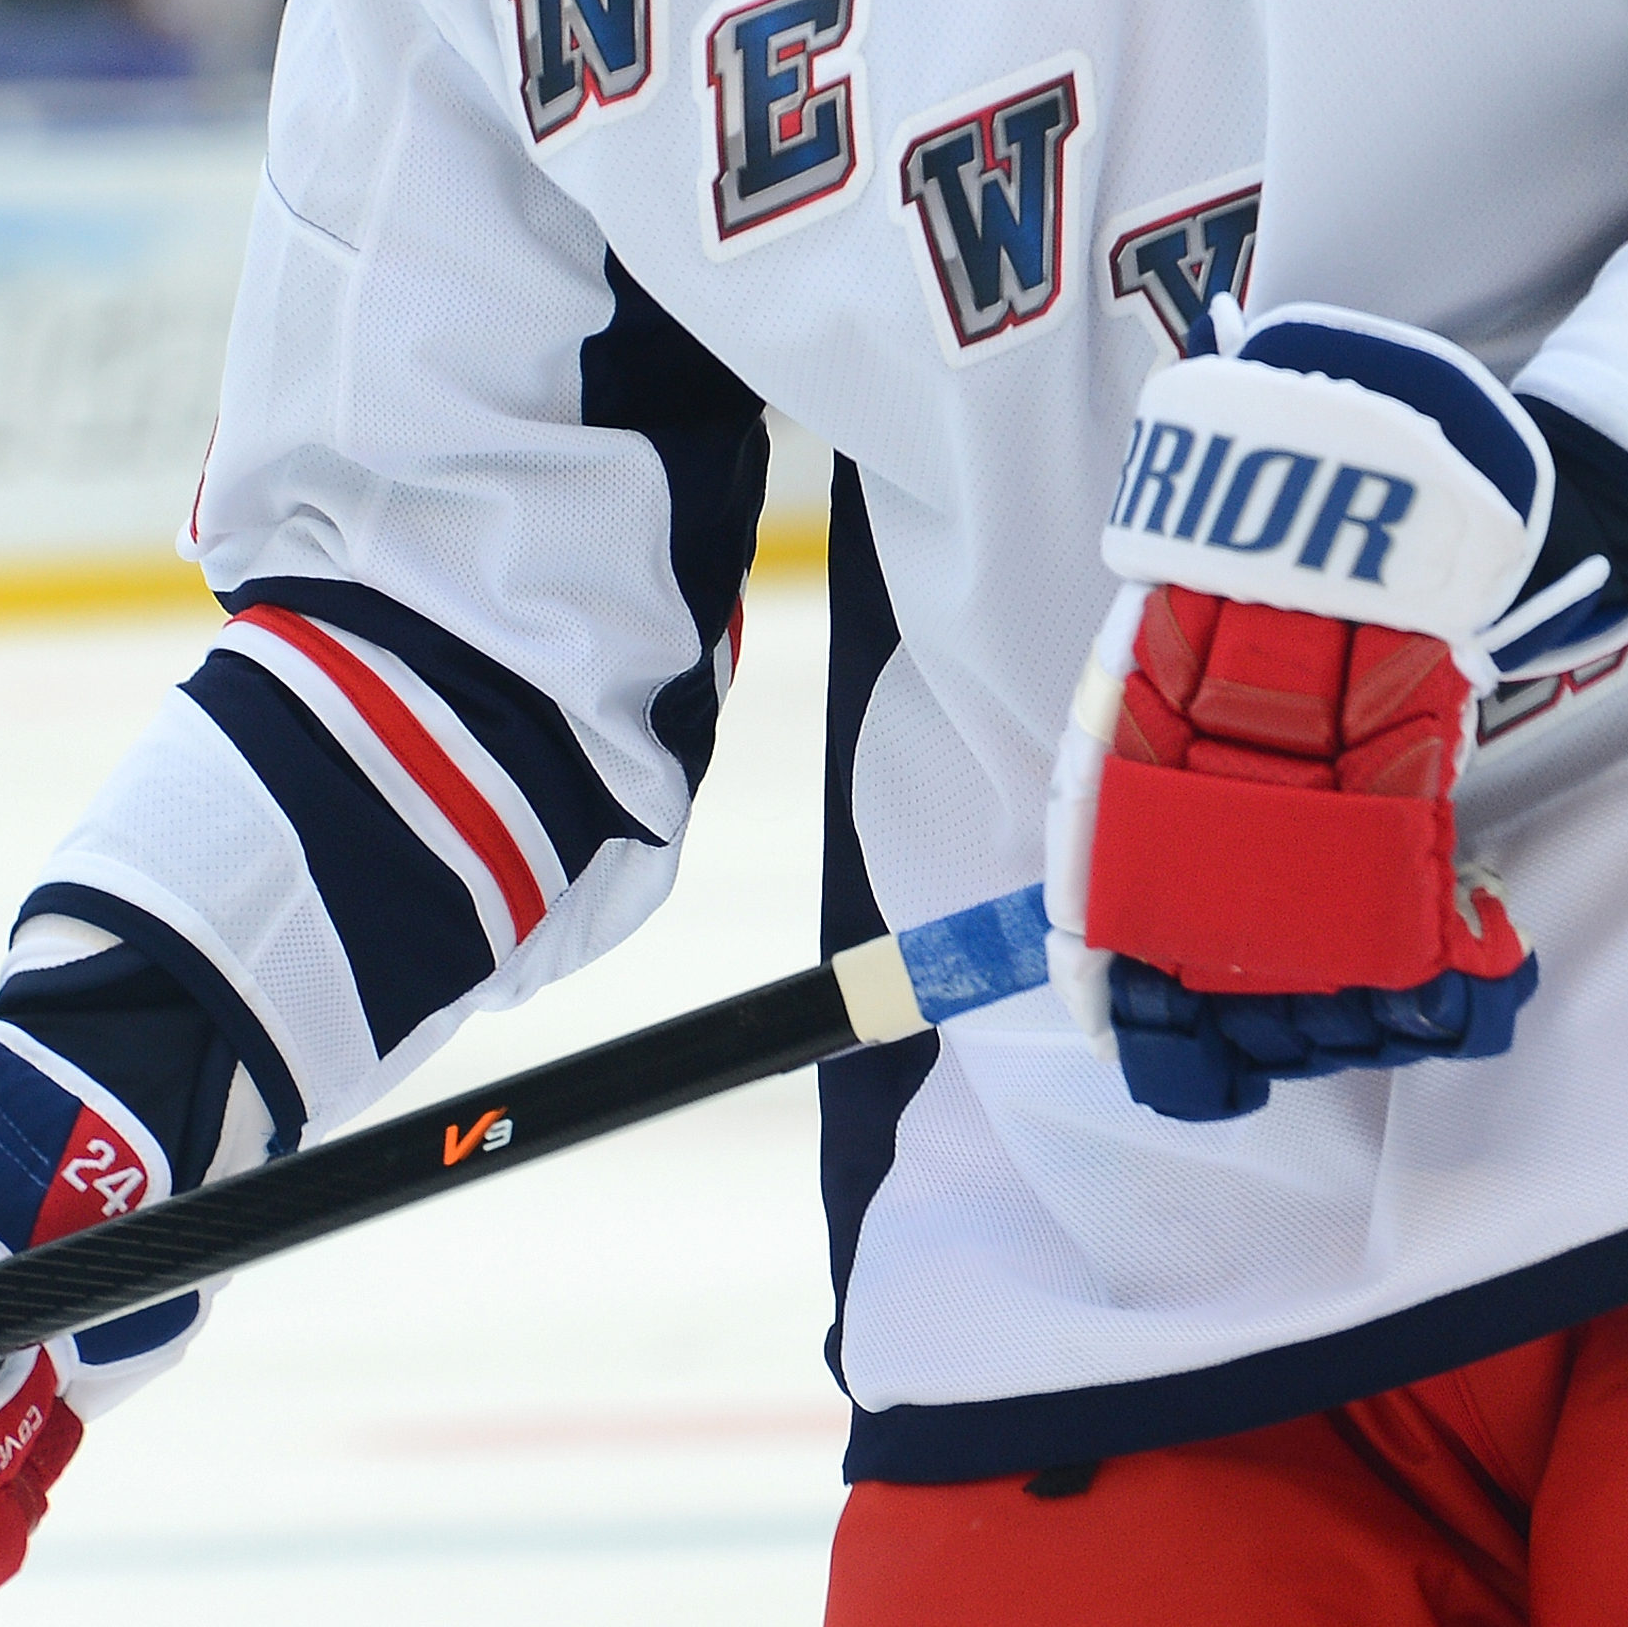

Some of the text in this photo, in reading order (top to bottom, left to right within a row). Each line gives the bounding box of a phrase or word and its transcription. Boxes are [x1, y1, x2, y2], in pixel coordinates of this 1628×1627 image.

[1111, 418, 1418, 589] RIOR
[443, 1106, 514, 1167] V9
[60, 1138, 145, 1218] 24
